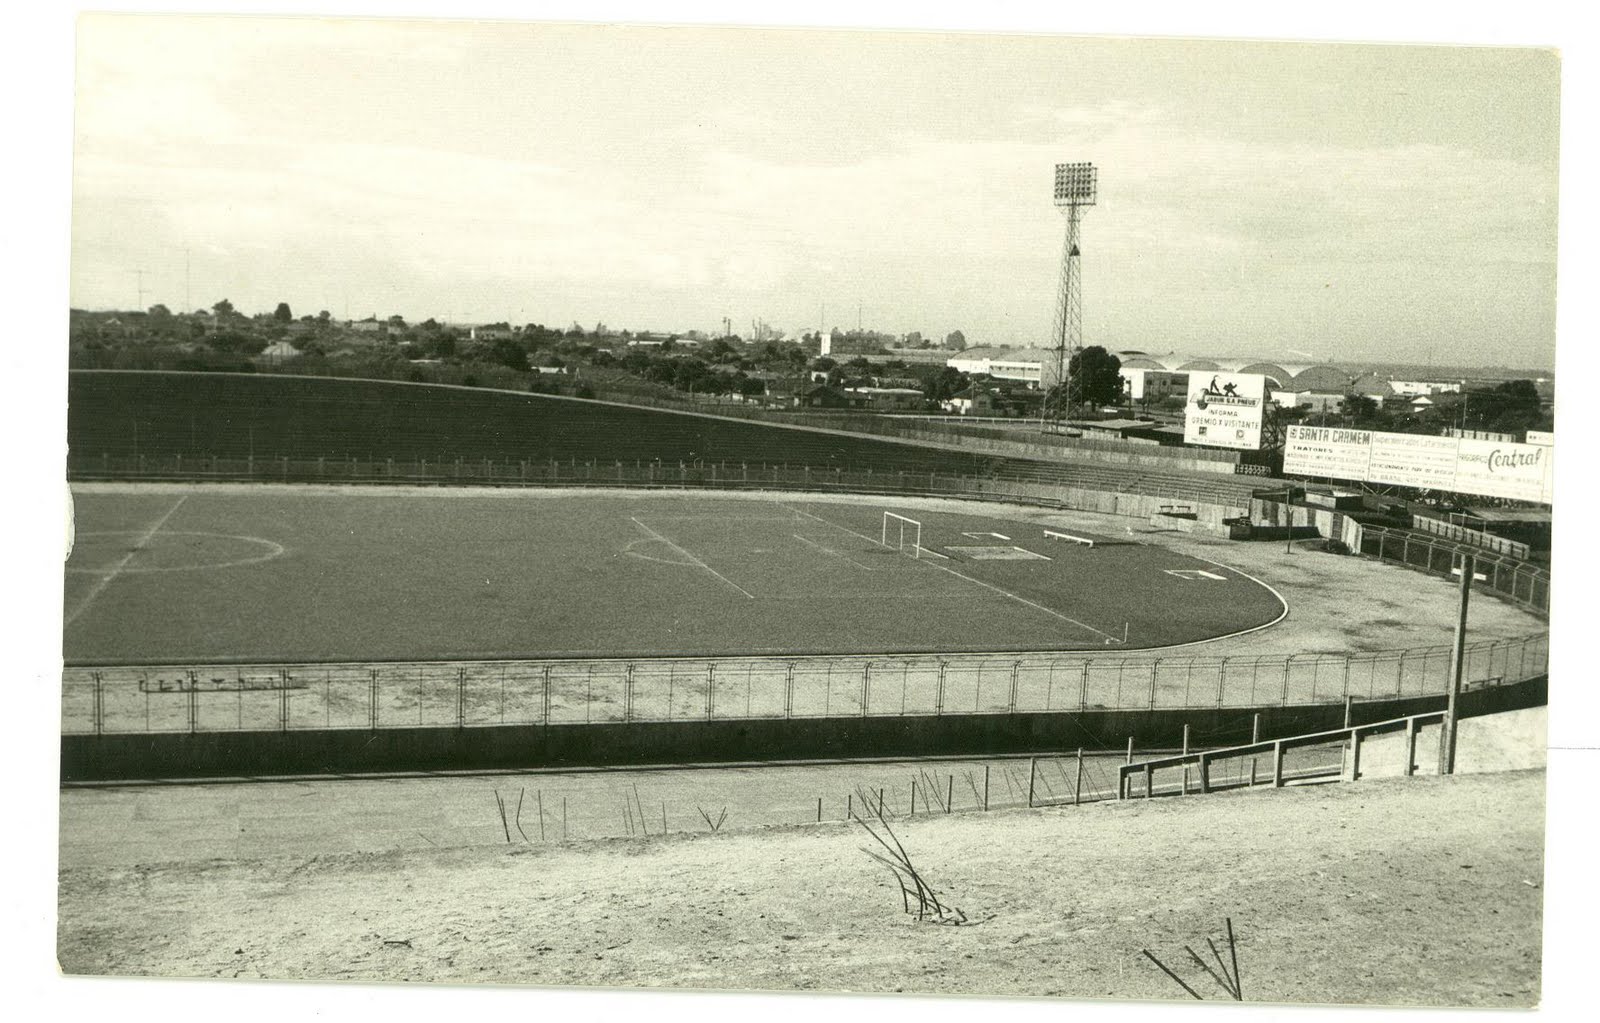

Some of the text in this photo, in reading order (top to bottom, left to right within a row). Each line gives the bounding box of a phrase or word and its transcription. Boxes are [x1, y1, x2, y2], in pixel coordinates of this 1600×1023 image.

[1224, 420, 1260, 430] VISITANTE
[1300, 428, 1371, 445] SANTA CARMEM
[1487, 447, 1543, 473] Central
